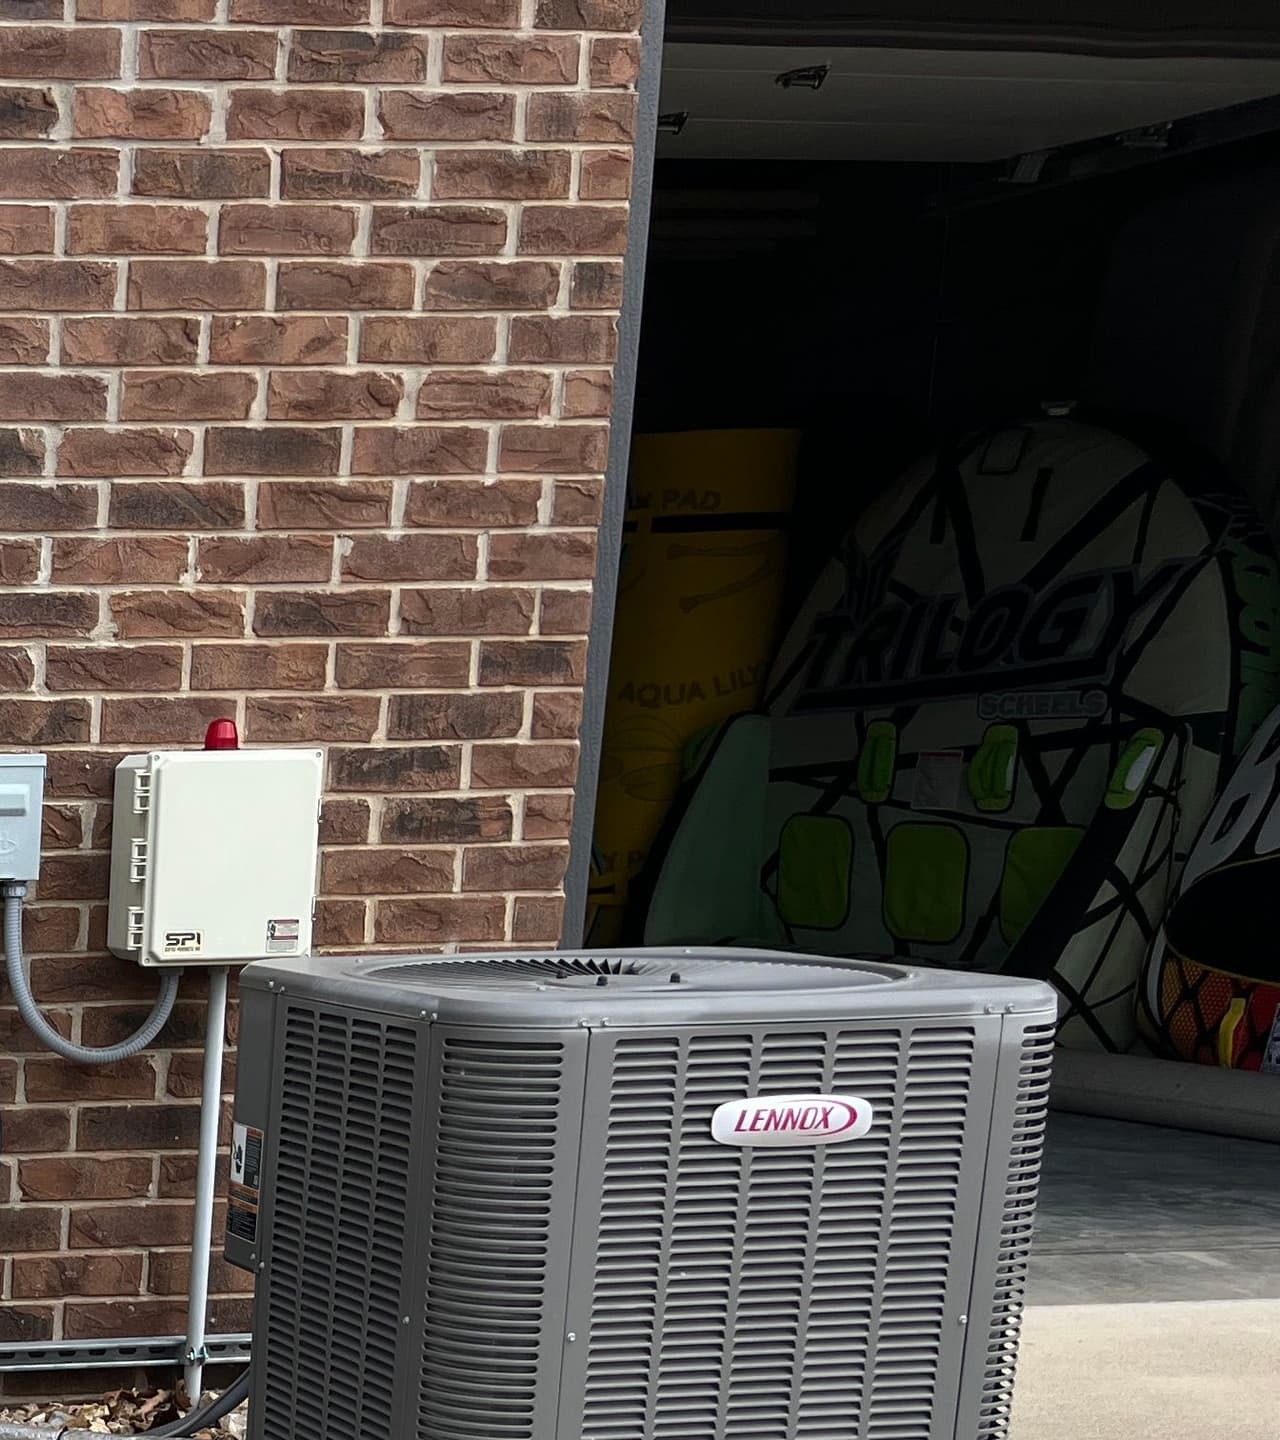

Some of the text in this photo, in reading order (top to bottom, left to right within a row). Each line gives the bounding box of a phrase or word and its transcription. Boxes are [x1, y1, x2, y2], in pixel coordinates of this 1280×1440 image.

[661, 487, 721, 512] PAD
[804, 560, 1186, 690] TRILOGY
[616, 680, 706, 707] AQUA
[165, 932, 201, 946] SPI
[734, 1106, 835, 1132] LENNOX
